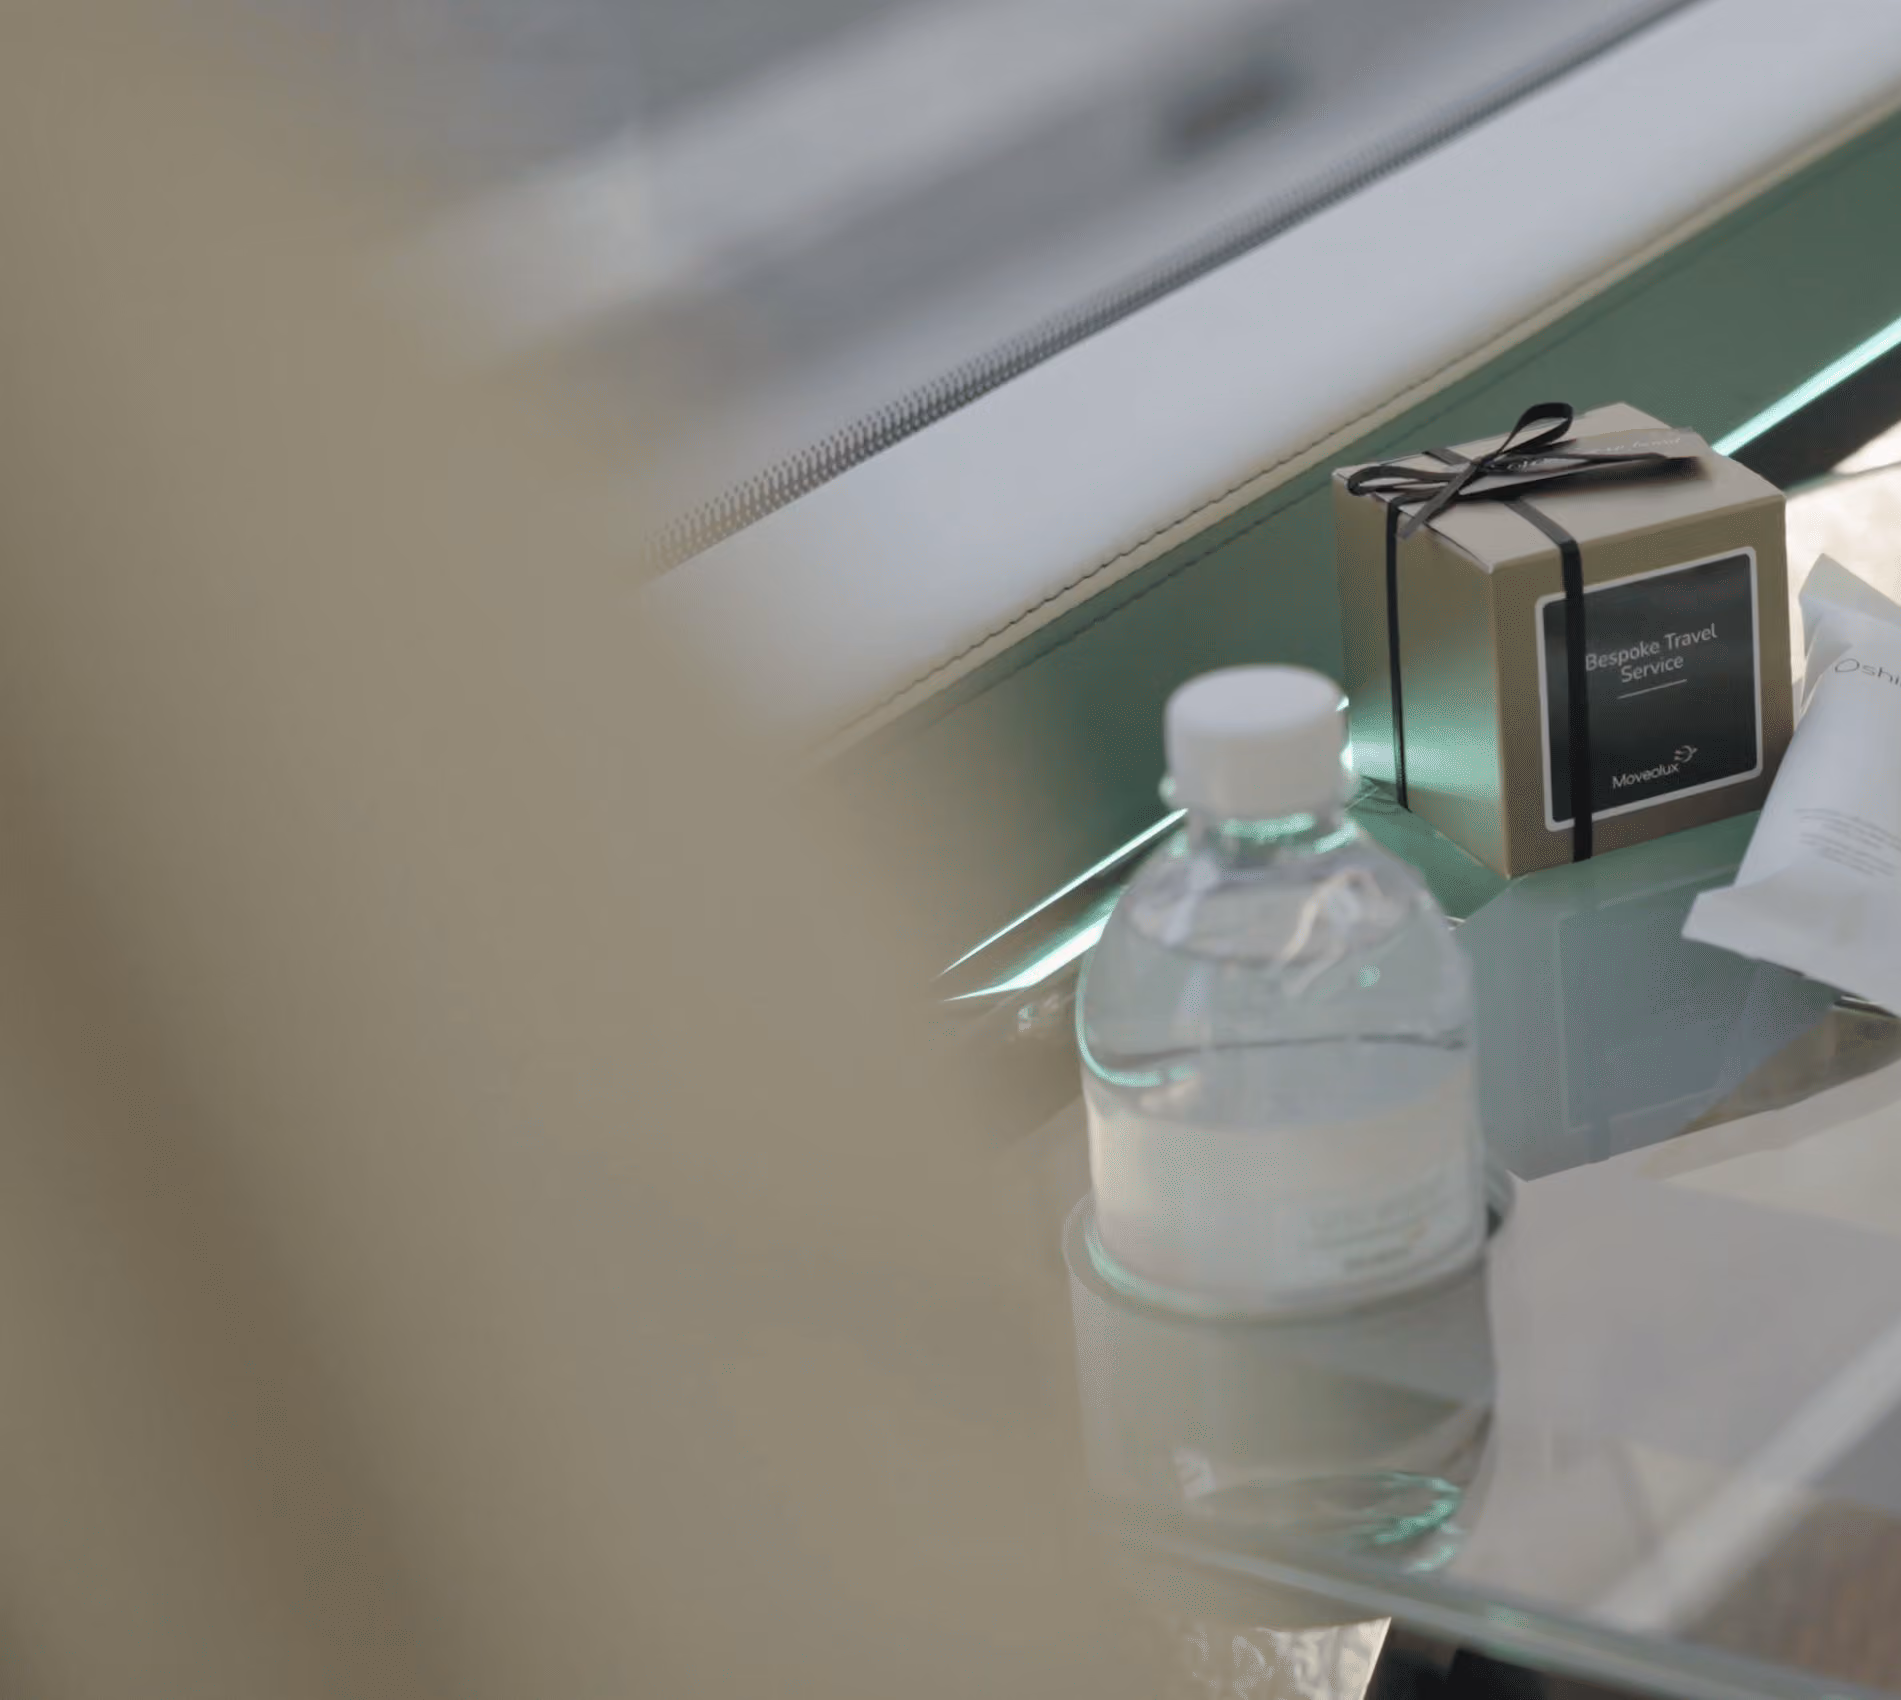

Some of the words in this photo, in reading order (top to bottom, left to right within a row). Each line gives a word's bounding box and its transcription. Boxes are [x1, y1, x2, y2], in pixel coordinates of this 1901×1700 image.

[1585, 640, 1660, 671] Bespoke
[1664, 622, 1718, 650] Travel
[1620, 655, 1684, 683] Service
